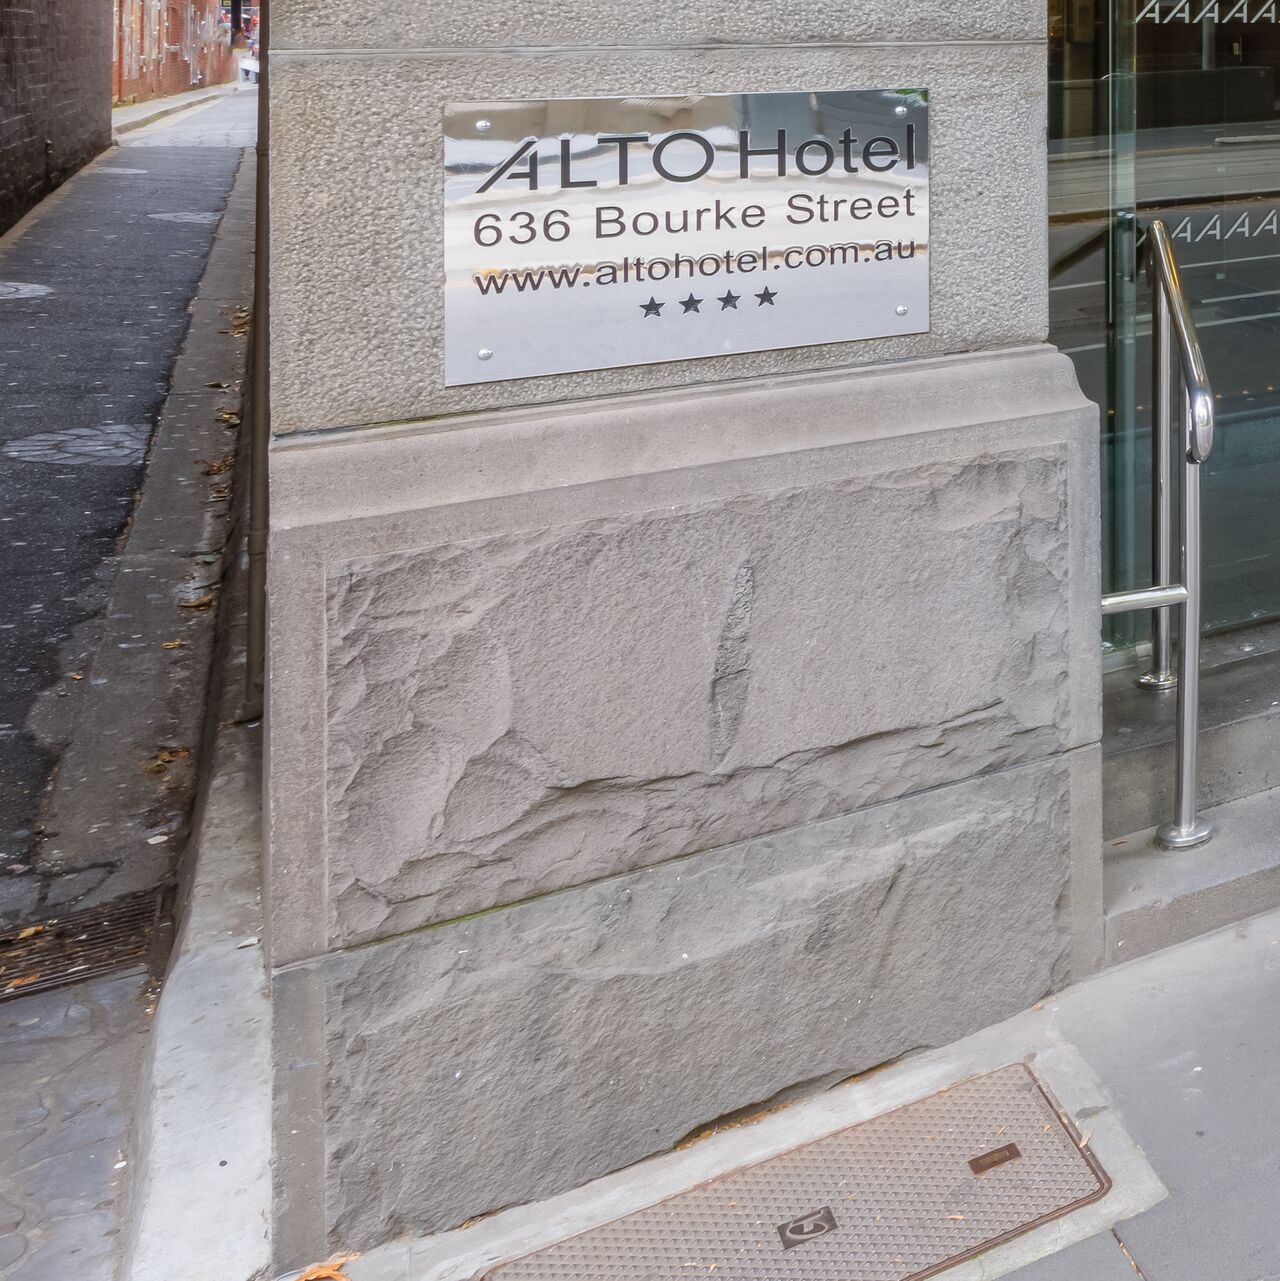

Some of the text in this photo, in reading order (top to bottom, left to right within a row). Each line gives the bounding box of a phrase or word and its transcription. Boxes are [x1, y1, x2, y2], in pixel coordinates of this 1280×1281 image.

[475, 123, 917, 194] ALTO Hotel
[473, 188, 917, 248] 636 Bourke Street
[475, 239, 917, 297] www.altohotel.com.au
